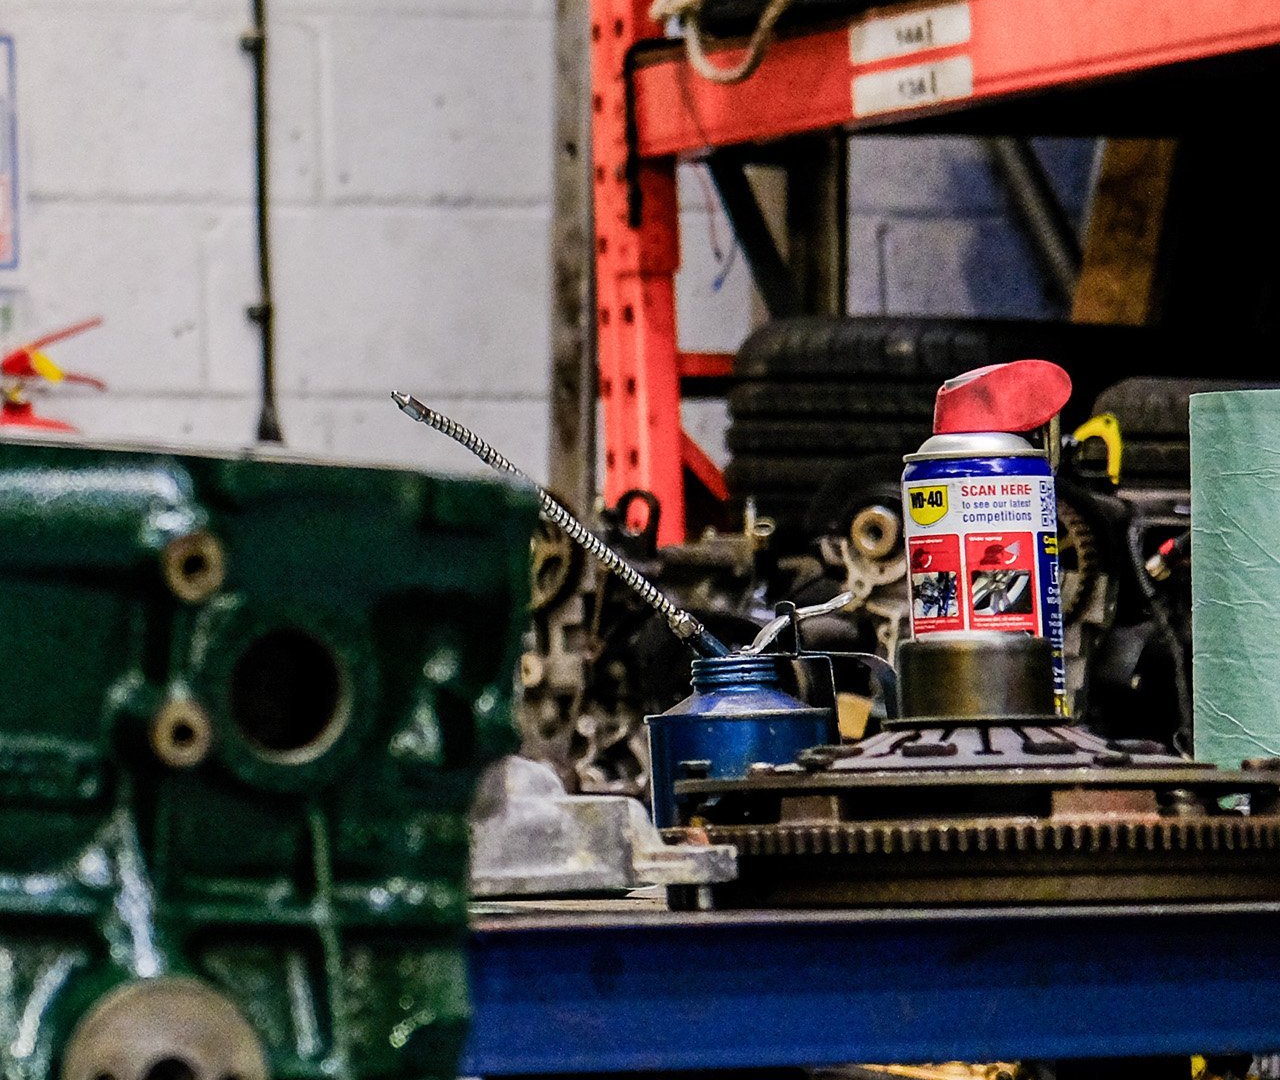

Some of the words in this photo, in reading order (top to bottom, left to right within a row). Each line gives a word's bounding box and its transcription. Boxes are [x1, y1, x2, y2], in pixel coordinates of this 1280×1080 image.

[961, 484, 996, 497] SCAN
[1001, 484, 1031, 495] HERE
[910, 490, 944, 509] WD-40
[962, 500, 971, 509] to
[973, 501, 990, 509] see
[992, 500, 1007, 508] our
[1009, 498, 1032, 508] latest
[962, 510, 1032, 524] competitions
